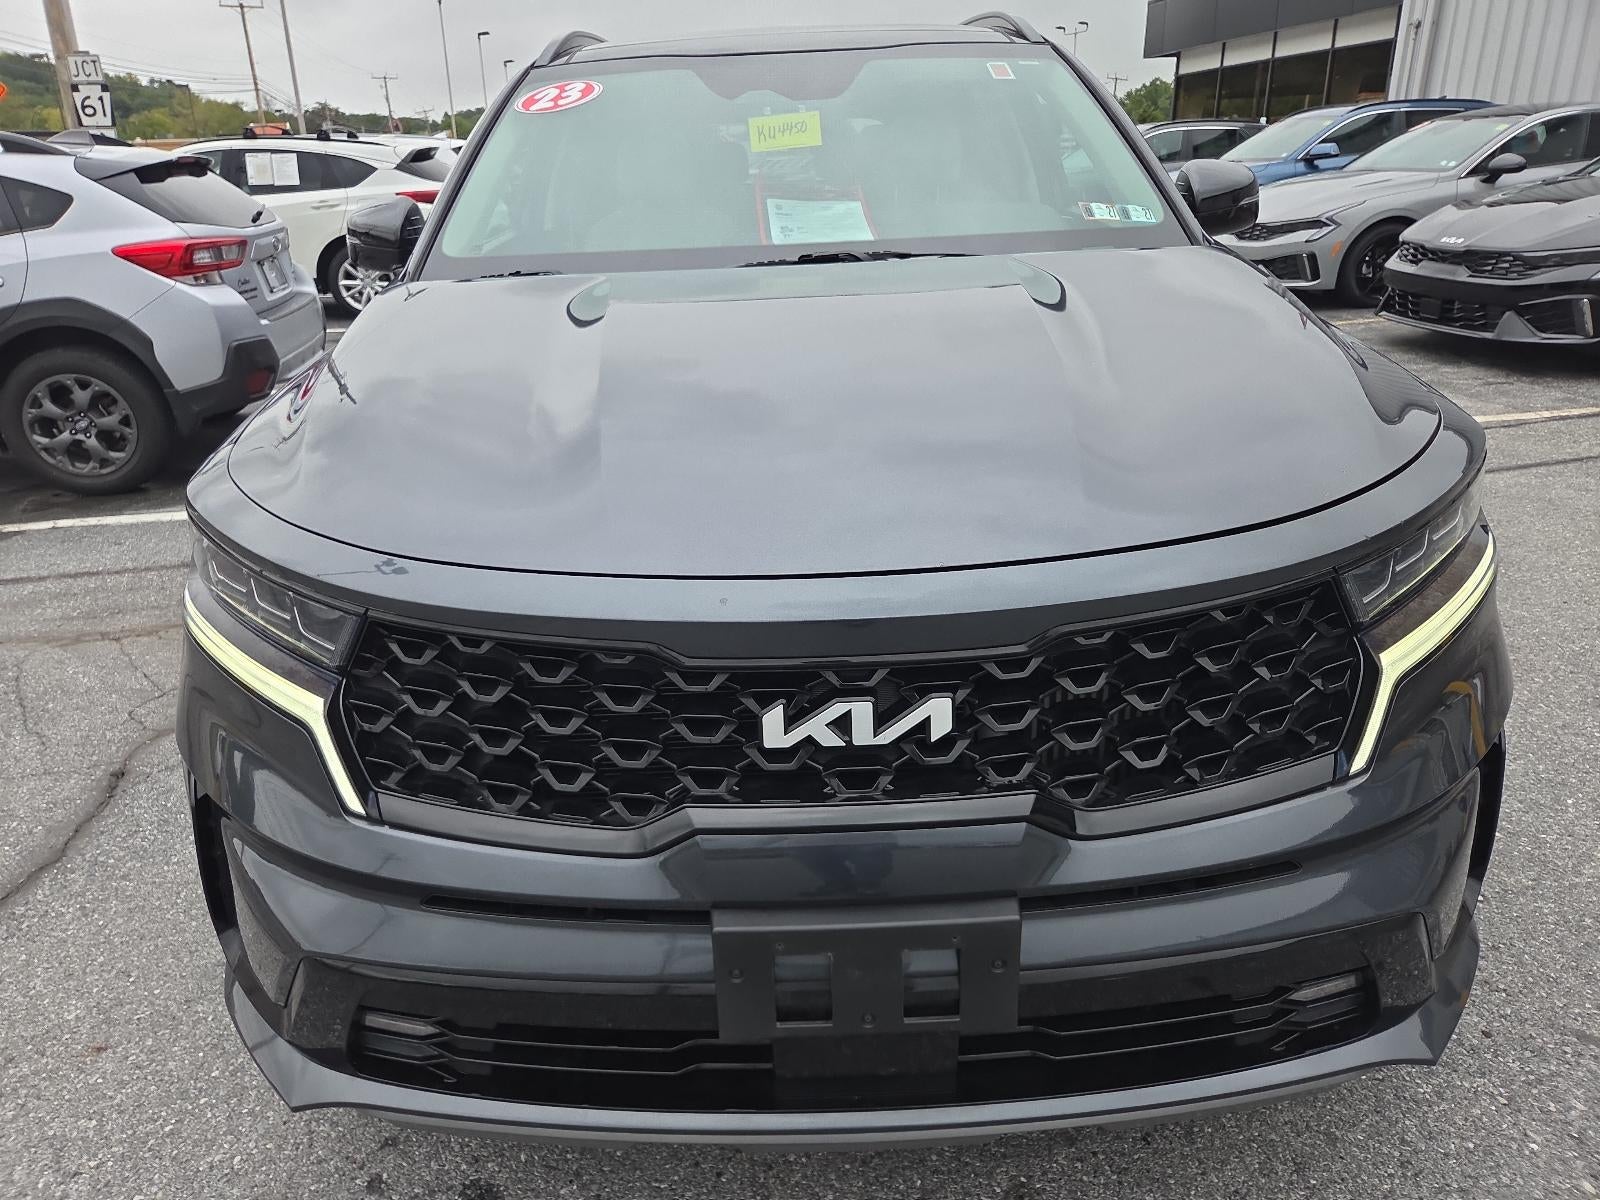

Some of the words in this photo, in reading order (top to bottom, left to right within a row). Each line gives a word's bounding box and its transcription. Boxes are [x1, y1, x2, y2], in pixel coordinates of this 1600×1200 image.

[73, 60, 98, 77] JCT
[81, 95, 107, 118] 61
[528, 82, 587, 111] 23
[762, 698, 953, 748] KIA
